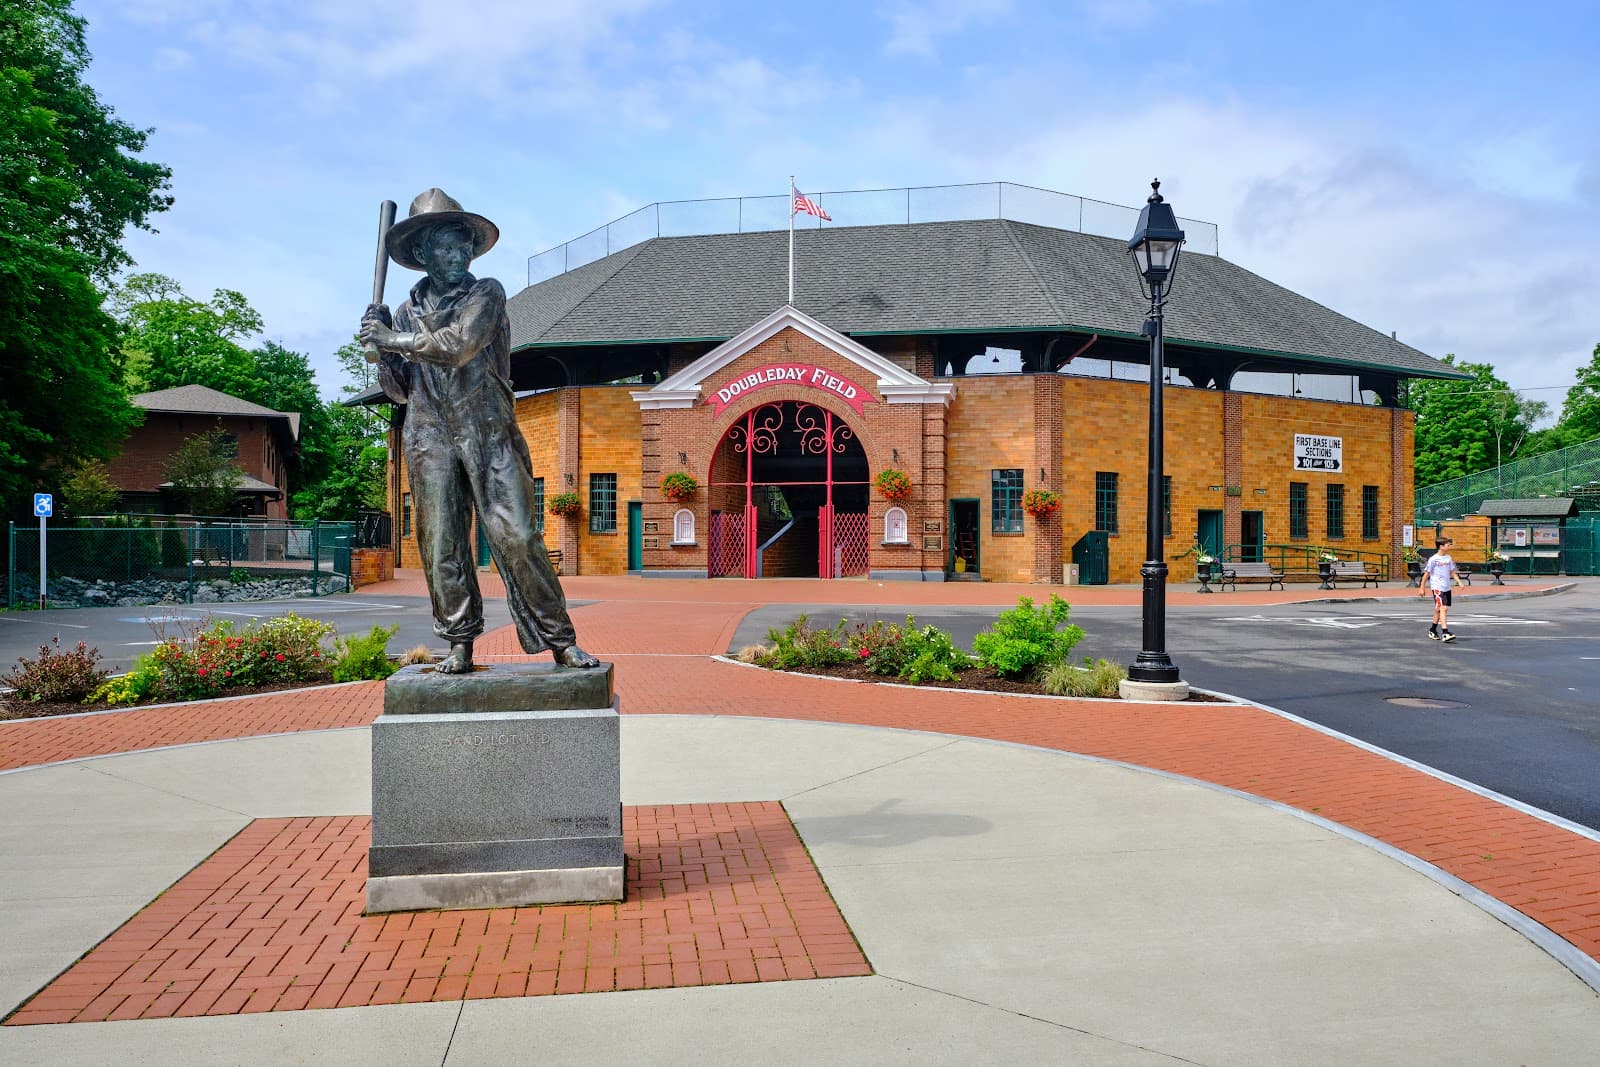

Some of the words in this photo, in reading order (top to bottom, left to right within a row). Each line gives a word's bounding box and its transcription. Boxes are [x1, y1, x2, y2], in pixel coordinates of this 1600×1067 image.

[717, 367, 808, 403] DOUBLEDAY
[811, 367, 857, 399] FIELD
[1296, 436, 1311, 447] FIRST
[1313, 438, 1327, 447] BASE
[1329, 440, 1341, 448] LINE
[1305, 447, 1332, 457] SECTIONS
[1303, 458, 1312, 468] 101
[490, 733, 517, 745] LOT
[526, 733, 550, 745] KD
